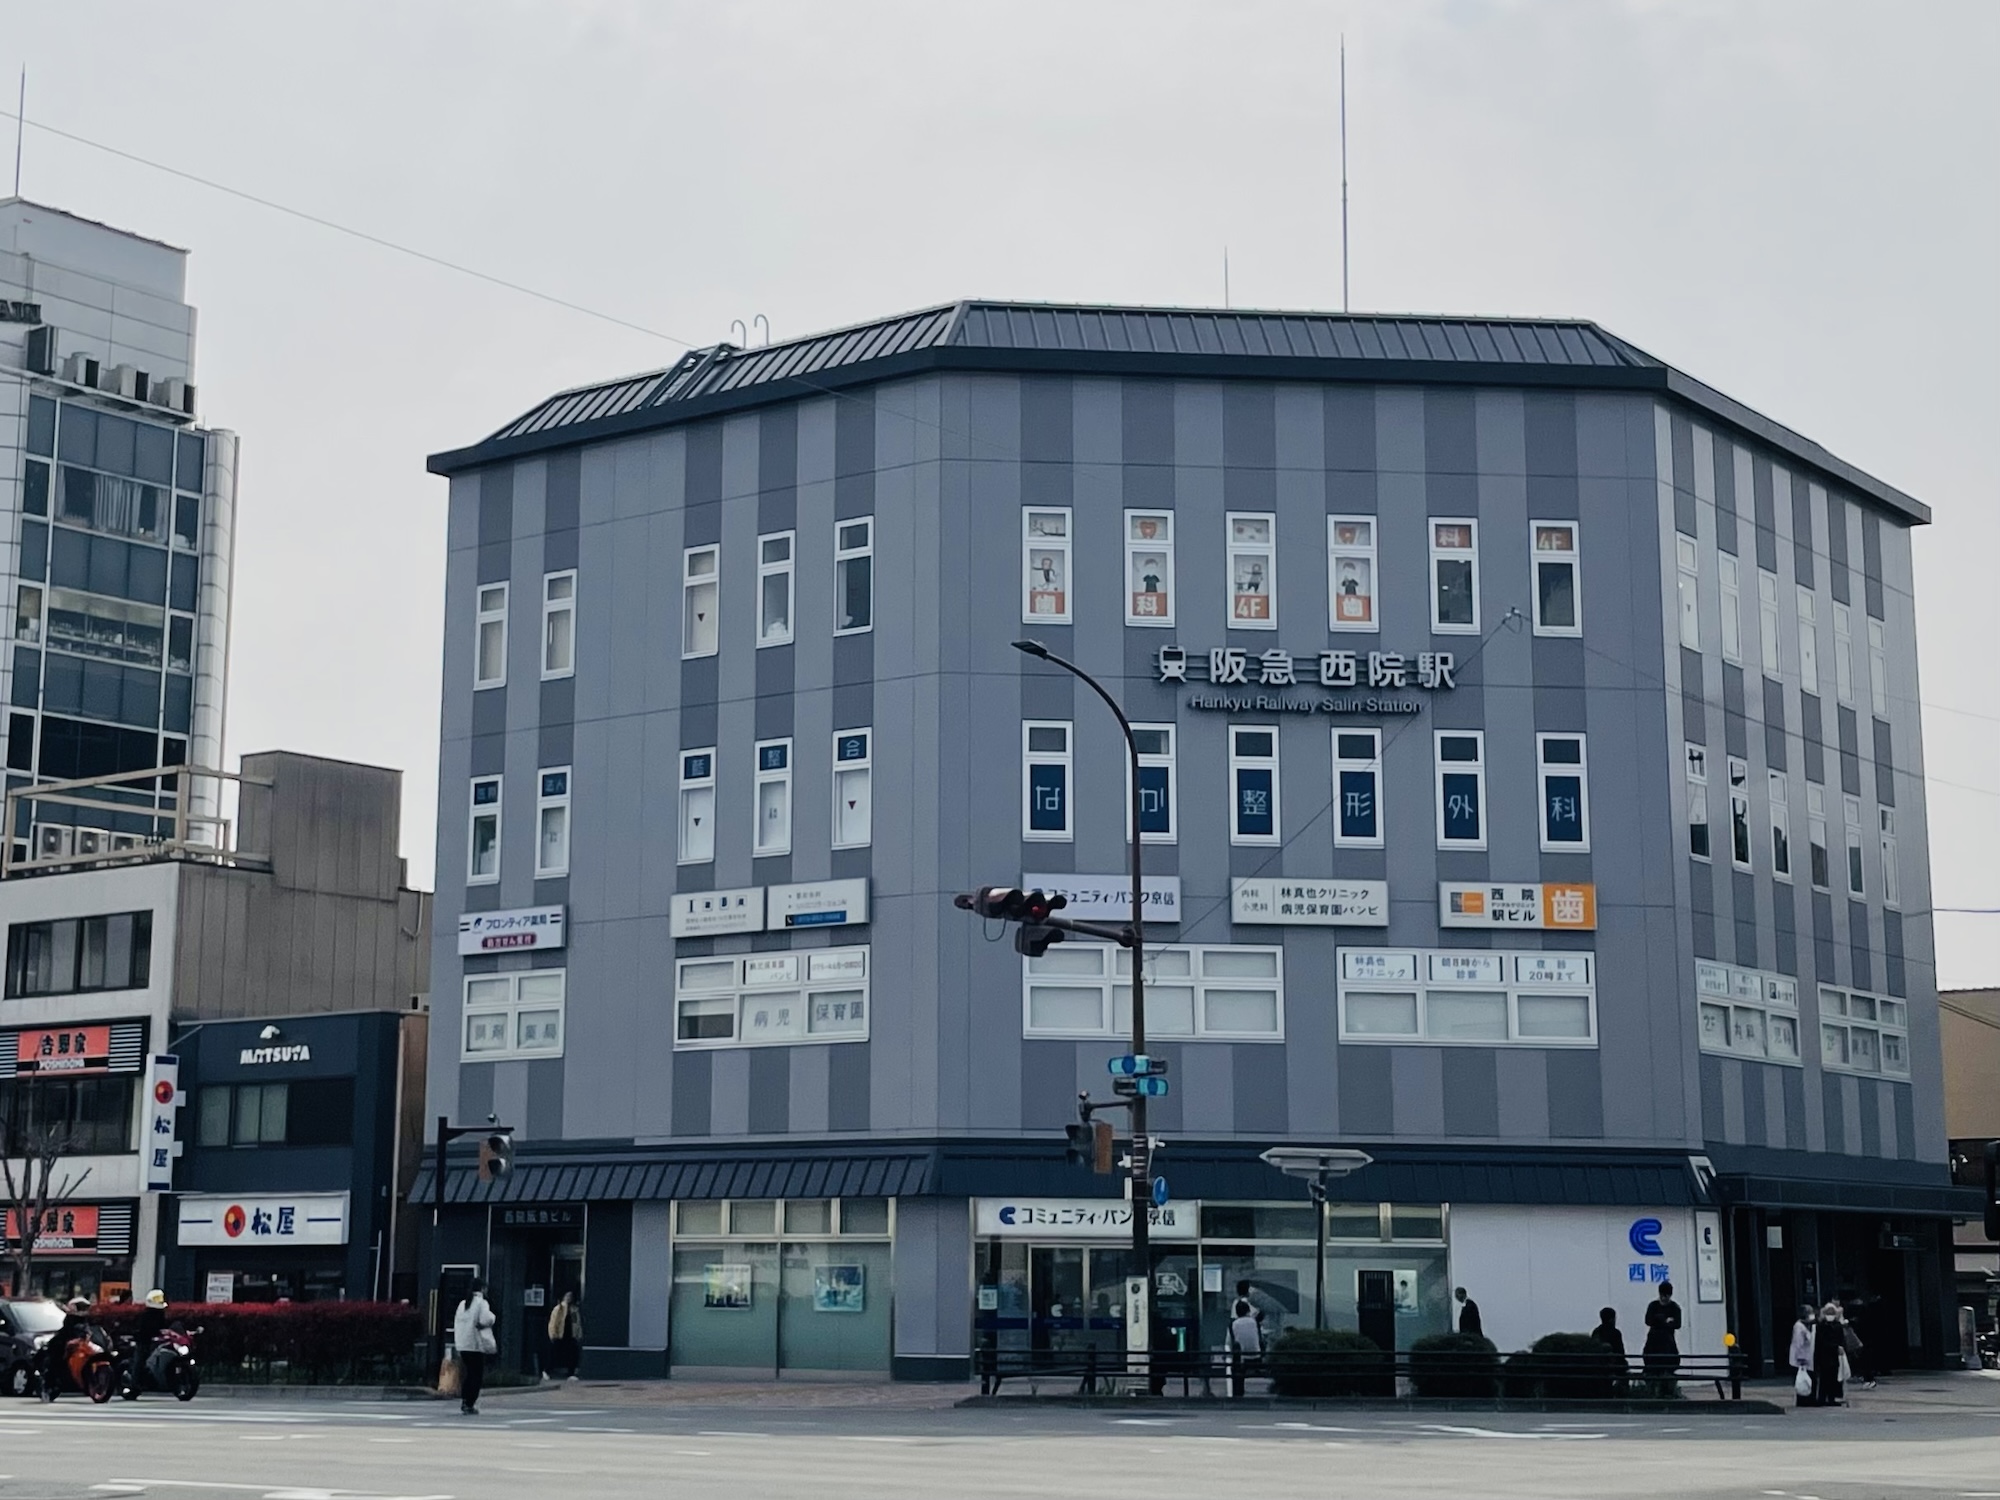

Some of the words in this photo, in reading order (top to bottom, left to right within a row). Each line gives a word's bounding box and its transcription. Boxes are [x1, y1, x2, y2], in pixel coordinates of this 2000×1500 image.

[1136, 595, 1158, 615] 科
[1236, 597, 1261, 617] 4F
[1191, 695, 1250, 711] Hankyu
[1256, 696, 1317, 712] Railway
[1366, 699, 1422, 713] Station
[846, 739, 861, 758] 会
[1346, 792, 1371, 817] 形
[1448, 794, 1474, 820] 外
[1551, 796, 1576, 822] 科
[1241, 889, 1260, 899] 内科
[1281, 887, 1370, 900] 林真也クリニック
[1281, 904, 1379, 916] 病児保育園バンビ
[1491, 909, 1536, 922] 駅ビル
[1356, 968, 1406, 978] クリニック
[153, 1115, 171, 1168] 松屋
[251, 1205, 296, 1237] 松屋
[1628, 1262, 1670, 1283] 西院
